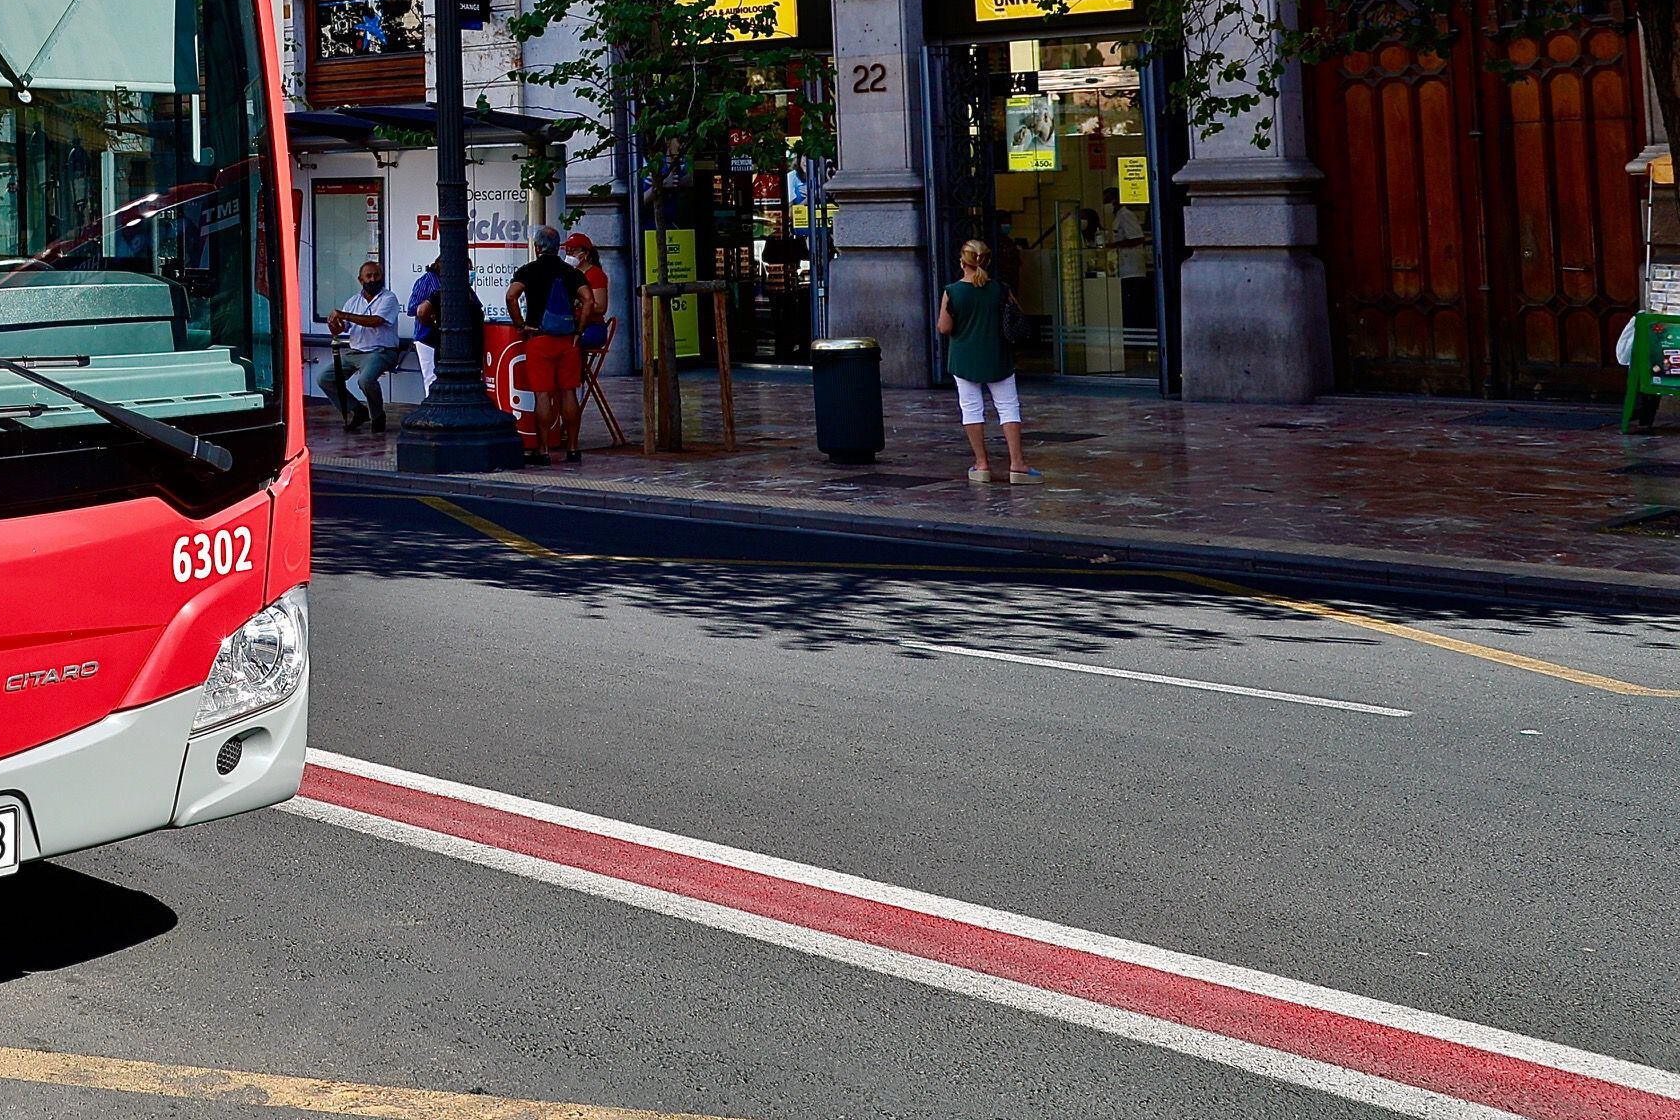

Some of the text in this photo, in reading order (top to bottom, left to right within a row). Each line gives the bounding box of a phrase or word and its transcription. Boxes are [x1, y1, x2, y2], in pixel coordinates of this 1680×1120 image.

[852, 63, 887, 94] 22
[466, 188, 528, 204] Descarreg
[476, 276, 504, 287] bitllet
[171, 525, 254, 583] 6302
[4, 661, 100, 693] CITARO
